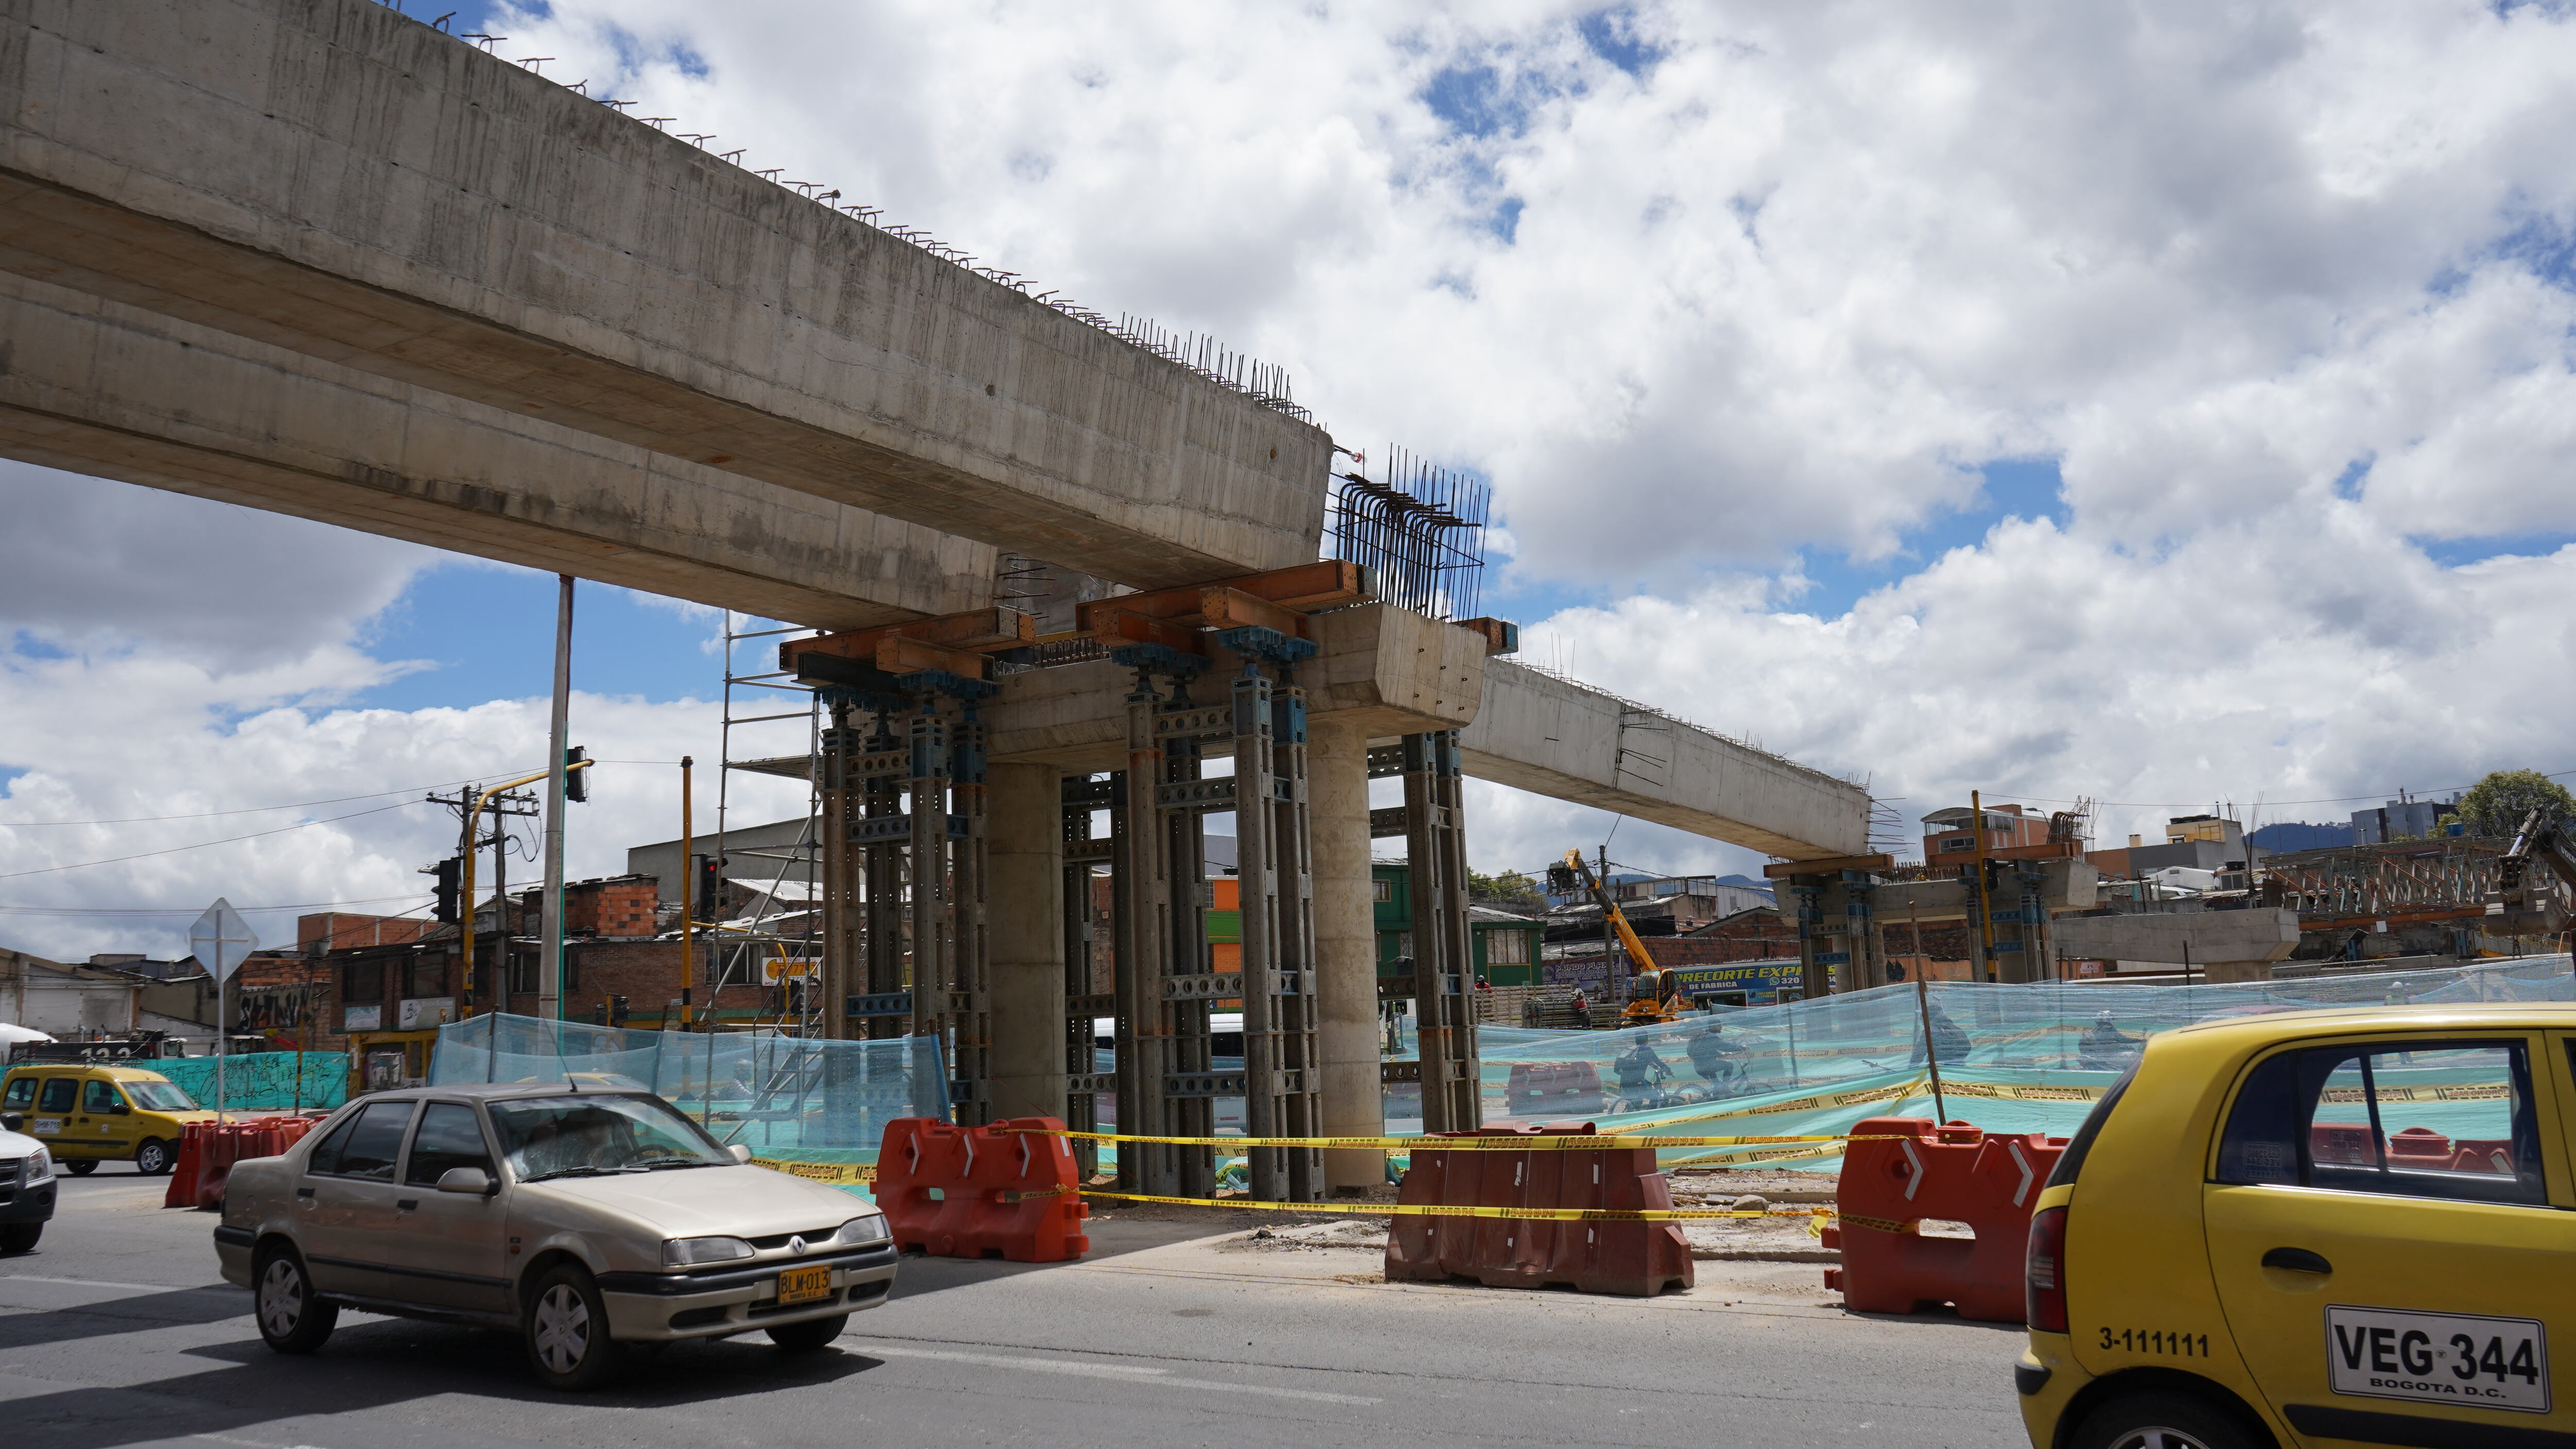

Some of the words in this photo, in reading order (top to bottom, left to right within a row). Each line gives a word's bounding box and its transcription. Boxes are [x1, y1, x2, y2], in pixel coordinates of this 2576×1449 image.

[2561, 845, 2576, 864] VOLV
[1555, 963, 1585, 973] MUNDO
[1675, 967, 1754, 983] PRECORTE
[1701, 981, 1738, 989] FABRICA
[781, 1269, 829, 1294] BLM-013
[2099, 1327, 2210, 1358] 3-111111
[2334, 1324, 2433, 1376] VEG
[2450, 1334, 2539, 1386] 344
[2370, 1377, 2458, 1394] BOGOTA
[2464, 1386, 2507, 1399] D.C.
